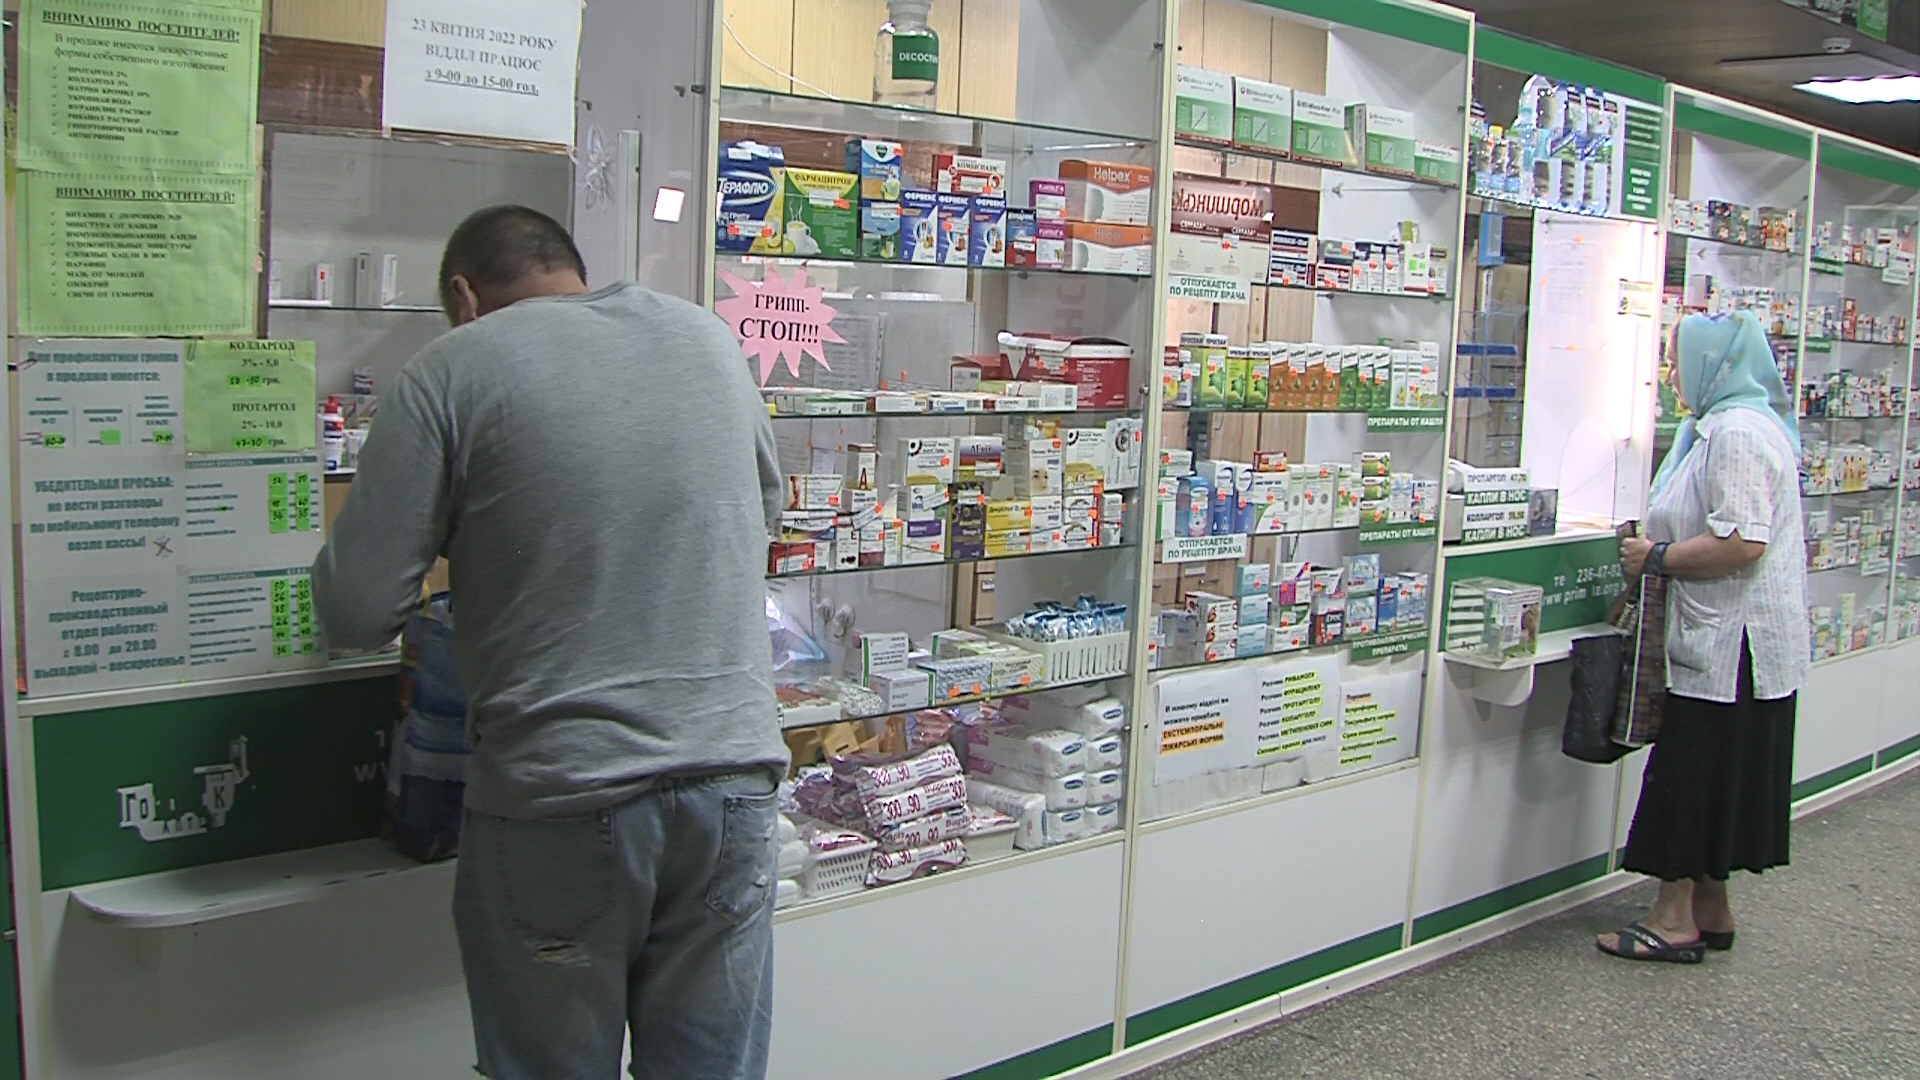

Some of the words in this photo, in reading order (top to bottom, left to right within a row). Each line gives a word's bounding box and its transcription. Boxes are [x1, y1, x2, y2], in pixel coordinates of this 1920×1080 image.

[42, 10, 131, 29] ВНИМАНИЮ
[138, 20, 240, 41] ПОСЕТИТЕЛЕЙ!
[55, 33, 63, 42] В
[67, 36, 110, 49] продаже
[412, 18, 426, 31] 23
[430, 21, 485, 40] КВІТНЯ
[488, 29, 515, 45] 2022
[519, 34, 557, 52] РОКУ
[435, 68, 461, 83] 9-00
[482, 75, 513, 90] 15-00
[1094, 166, 1131, 182] Helpex
[718, 177, 769, 194] ТЕРАФЛЮ
[55, 187, 136, 200] ВНИМАНИЮ
[142, 189, 236, 203] ПОСЕТИТЕЛЕЙ!
[1180, 277, 1237, 290] ОТПУСКАЕТСЯ
[1169, 287, 1182, 296] ПО
[1185, 288, 1220, 299] РЕЦЕПТУ
[1220, 290, 1246, 301] ВРАЧА
[754, 294, 810, 313] ГРИПП-
[739, 317, 819, 344] СТОП!!!
[229, 342, 295, 351] КОЛЛАРГОЛ
[232, 403, 296, 412] ПРОТАРГОЛ
[1367, 417, 1410, 427] ПРЕПАРАТЫ
[1410, 417, 1420, 426] ОТ
[35, 478, 119, 493] УБЕДИТЕЛЬНАЯ
[122, 476, 174, 489] ПРОСЬБА:
[1508, 489, 1527, 502] НОС
[64, 501, 98, 511] вести
[47, 519, 121, 532] мобильному
[124, 517, 180, 528] телефону
[1506, 525, 1525, 539] НОС
[1178, 537, 1234, 548] ОТПУСКАЕТСЯ
[1359, 530, 1401, 541] ПРЕПАРАТЫ
[1402, 529, 1412, 538] ОТ
[1168, 549, 1180, 559] ПО
[1182, 547, 1216, 559] РЕЦЕПТУ
[1217, 545, 1243, 556] ВРАЧА
[71, 588, 147, 603] Рецептурно-
[48, 601, 169, 623] производственный
[101, 622, 158, 637] работает:
[109, 655, 185, 672] воскресенье
[908, 793, 921, 813] 90
